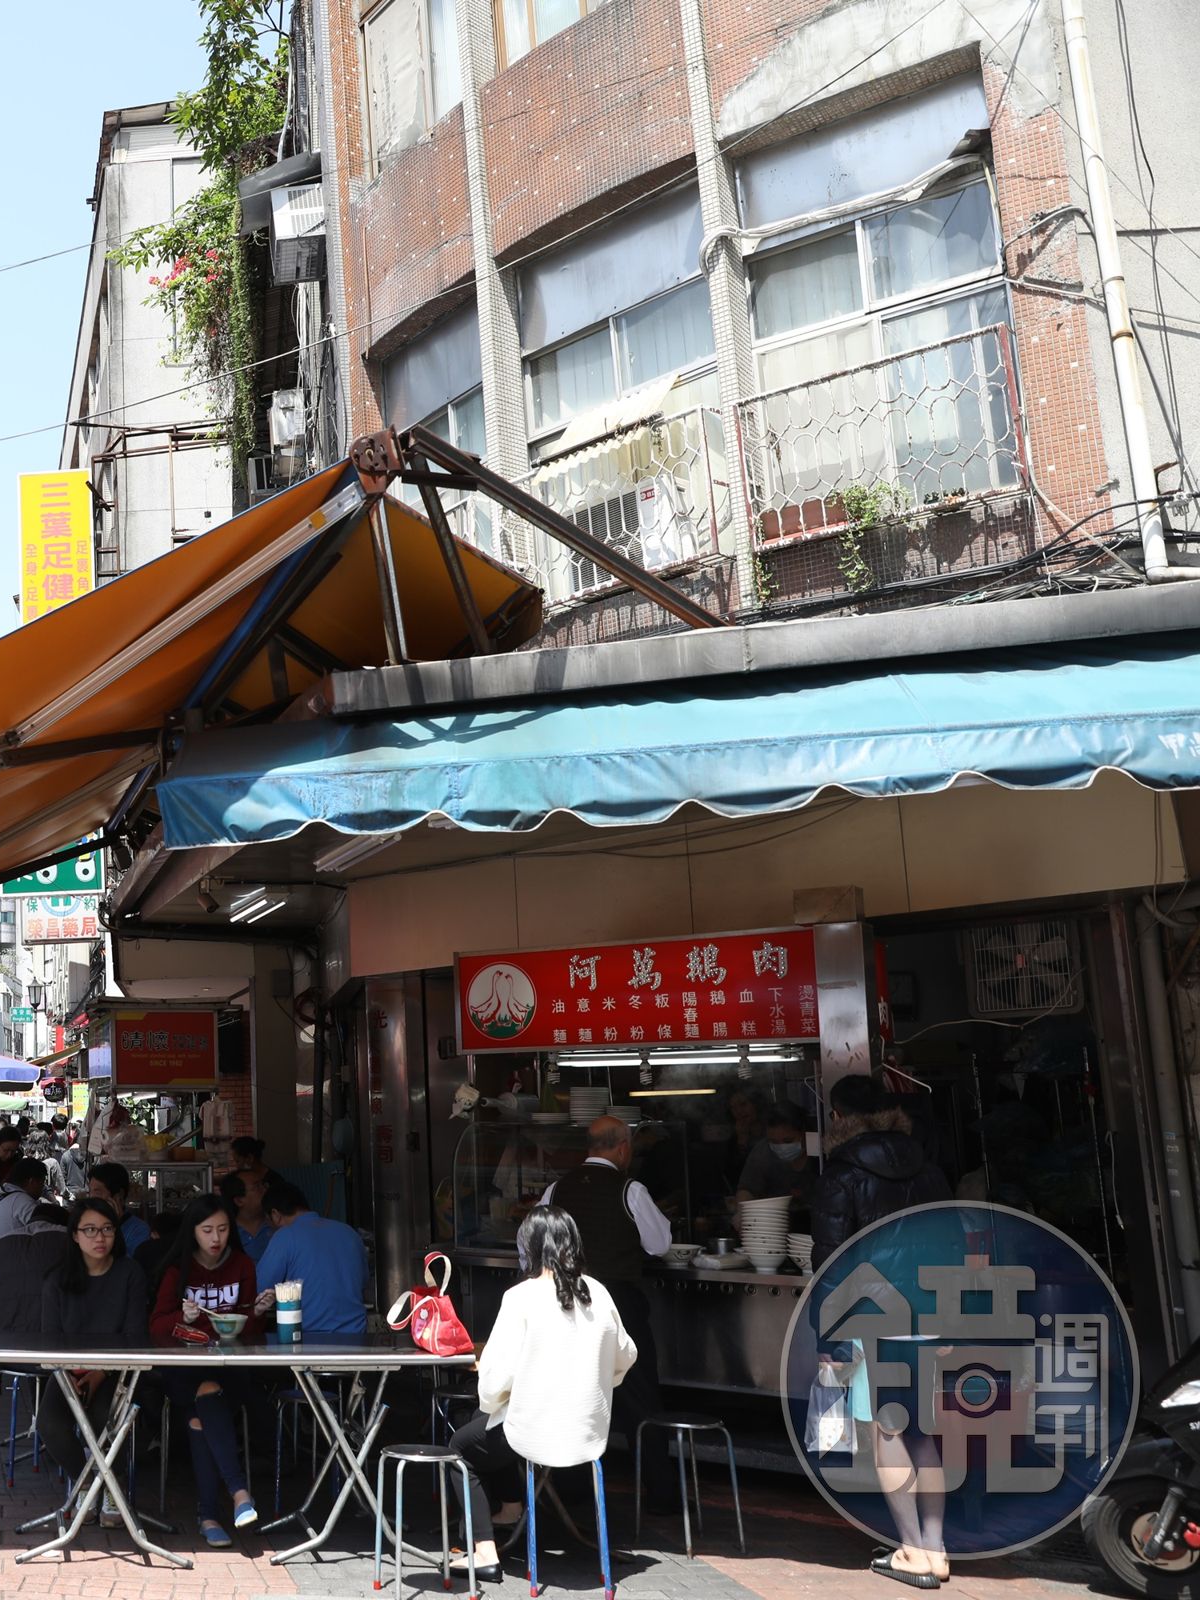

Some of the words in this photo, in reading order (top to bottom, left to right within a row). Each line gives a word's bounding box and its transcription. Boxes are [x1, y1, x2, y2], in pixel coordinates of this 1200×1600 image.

[40, 482, 74, 613] 三葉足健
[568, 941, 790, 991] 阿萬鵝肉
